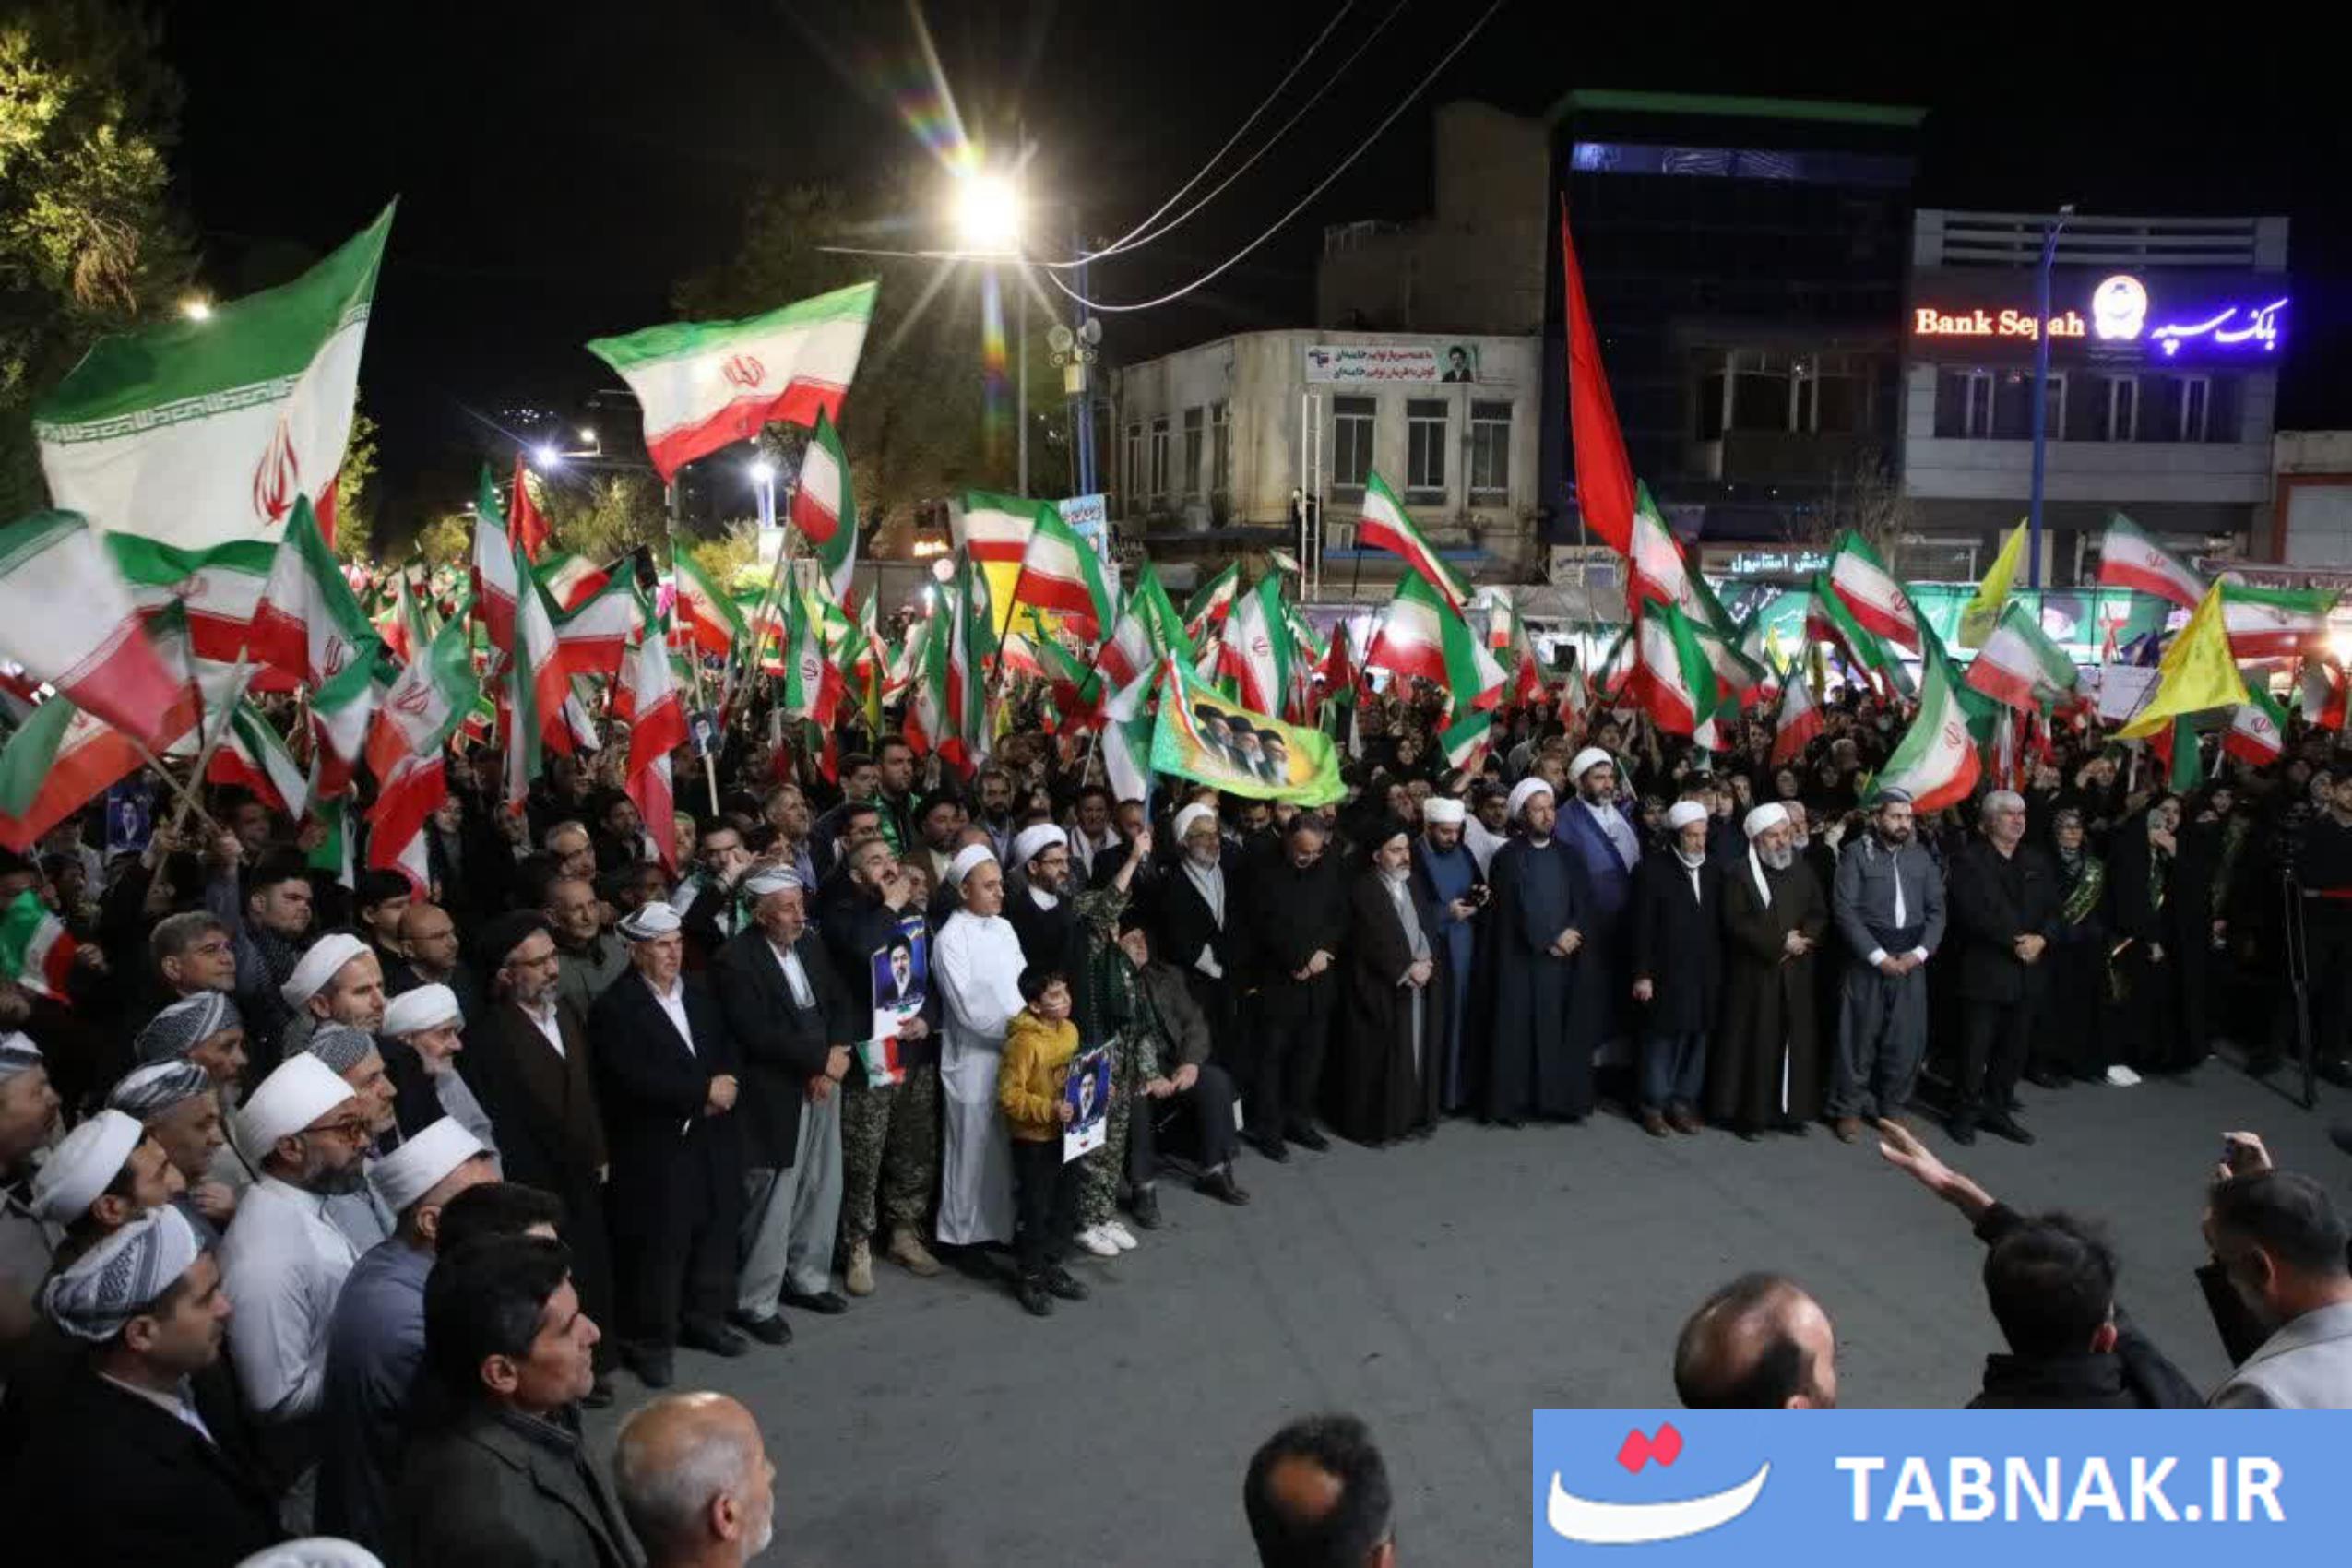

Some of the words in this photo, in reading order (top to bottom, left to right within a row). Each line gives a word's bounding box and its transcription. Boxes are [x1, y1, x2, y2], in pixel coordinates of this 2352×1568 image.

[1915, 308, 1993, 335] Bank
[2150, 307, 2237, 356] سپه
[2215, 298, 2288, 350] بانک
